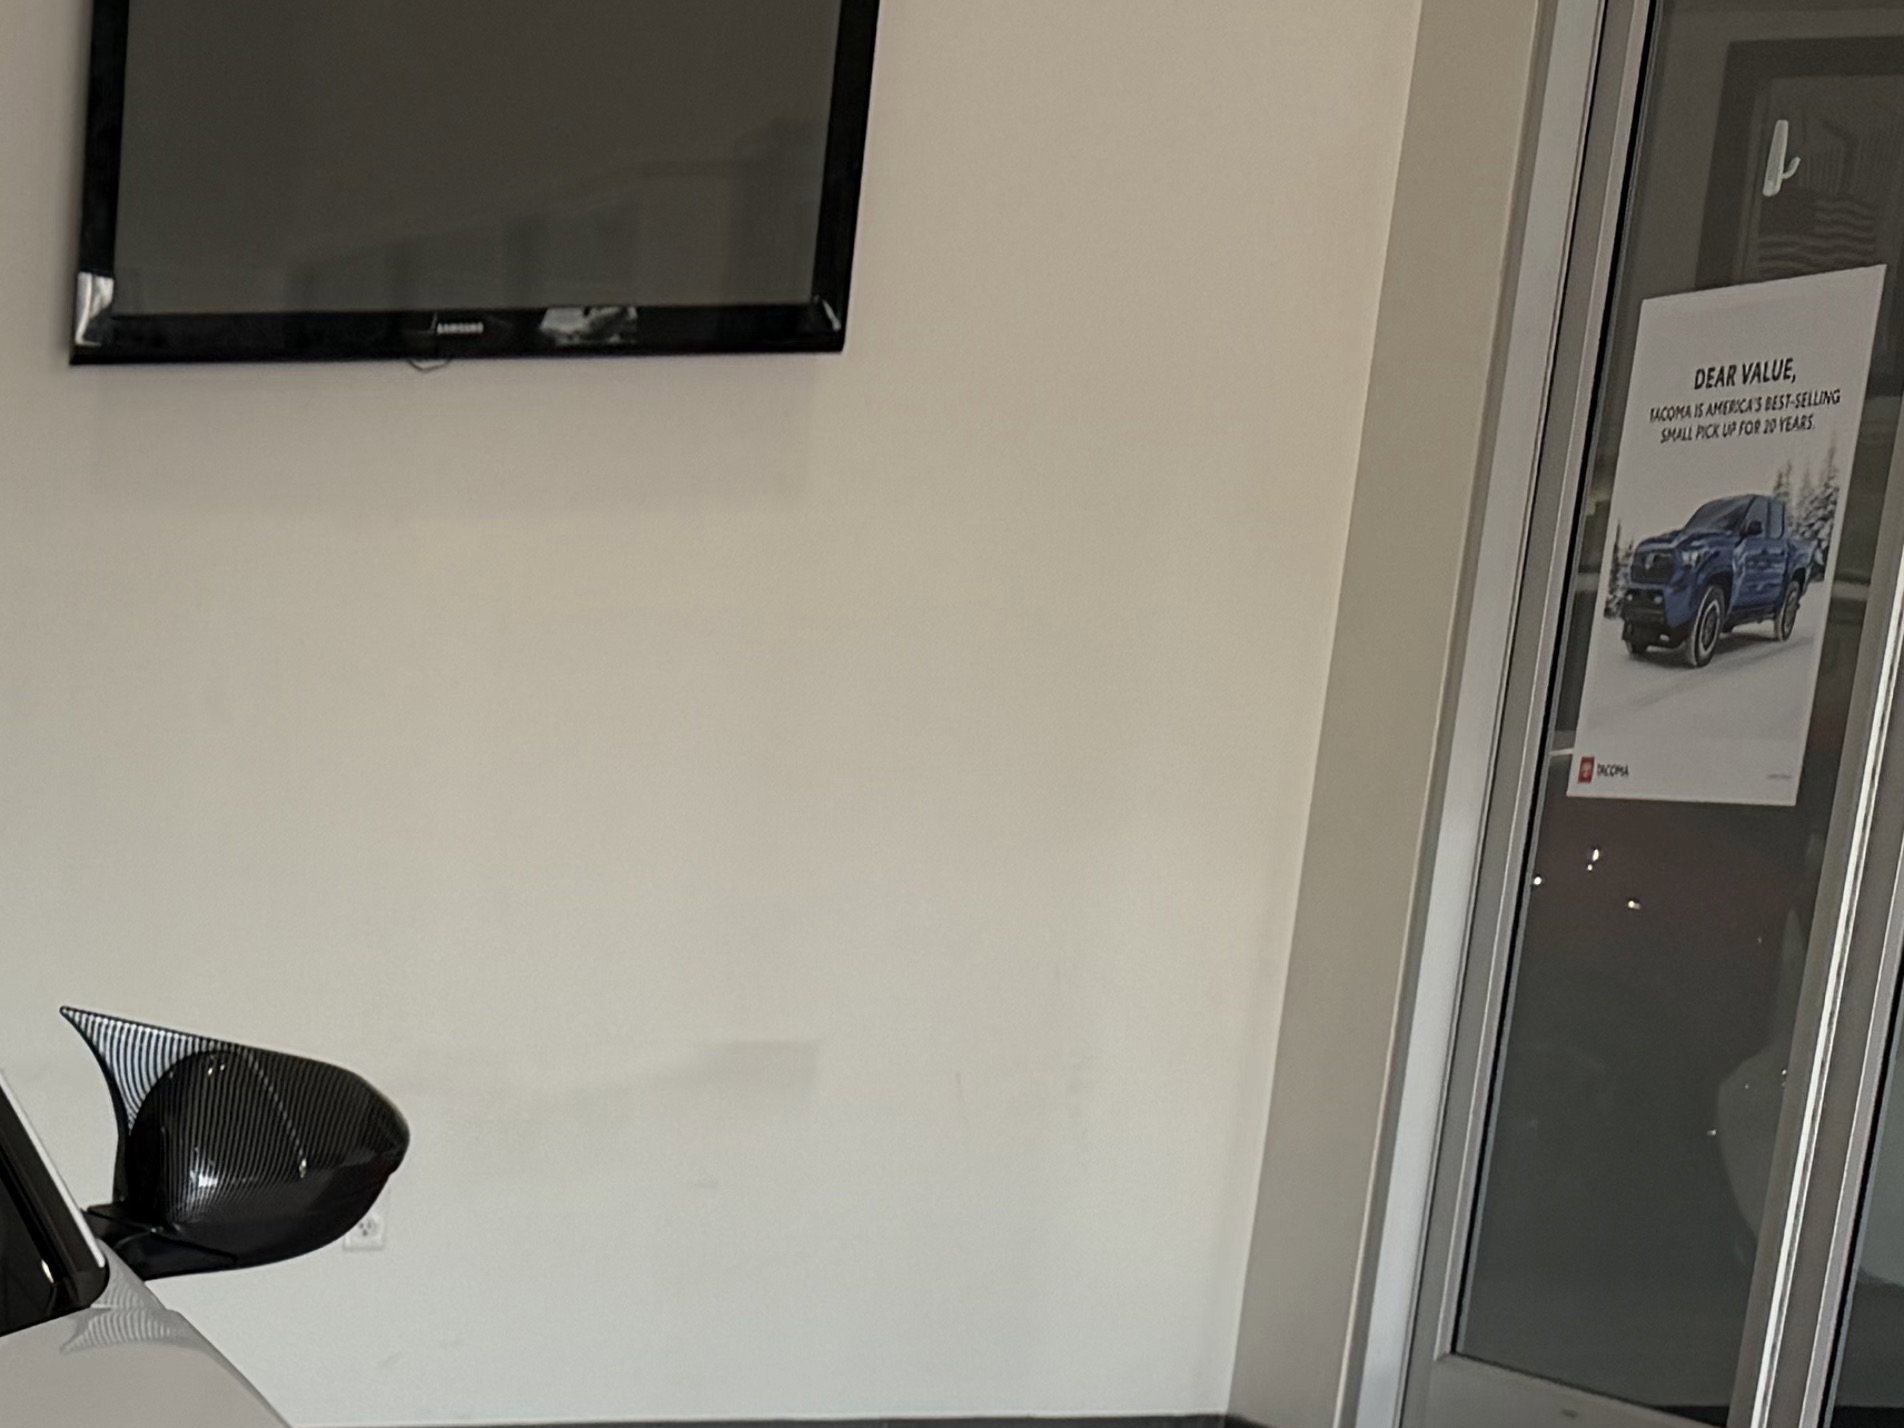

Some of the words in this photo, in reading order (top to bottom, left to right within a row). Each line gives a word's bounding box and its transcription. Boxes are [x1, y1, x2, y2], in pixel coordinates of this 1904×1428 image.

[1694, 364, 1737, 390] DEAR
[1742, 357, 1796, 385] VALUE,
[1649, 405, 1691, 423] TACOMA
[1694, 403, 1703, 418] IS
[1660, 426, 1692, 444] SMALL
[1695, 424, 1719, 440] PICK
[1723, 422, 1737, 438] UP
[1739, 419, 1761, 436] FOR
